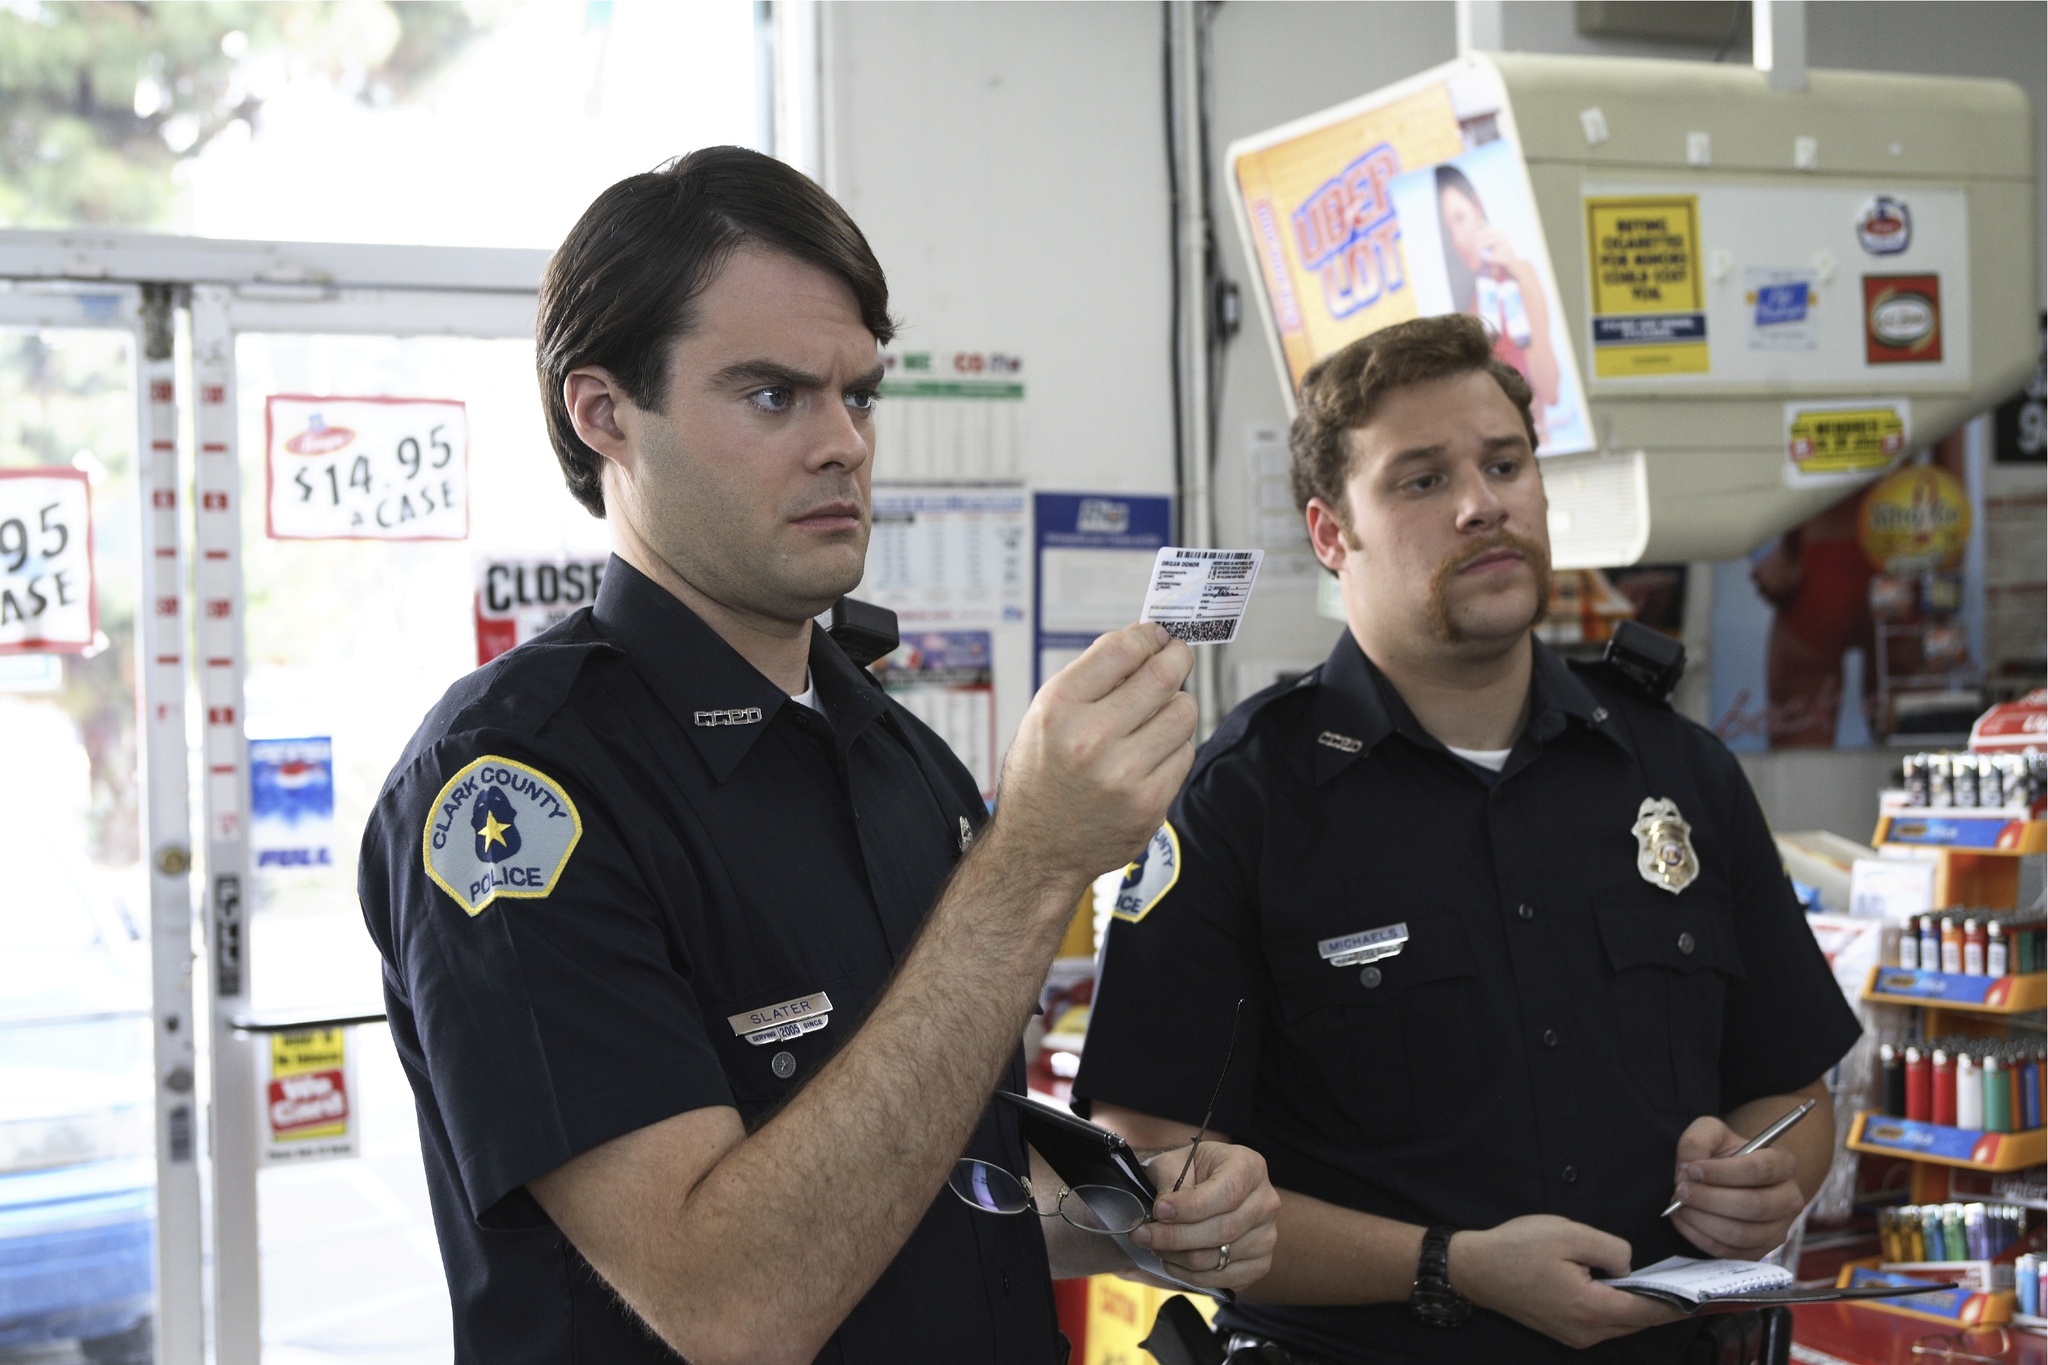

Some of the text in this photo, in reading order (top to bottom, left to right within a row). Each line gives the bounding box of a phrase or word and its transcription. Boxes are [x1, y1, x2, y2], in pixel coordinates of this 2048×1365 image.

[375, 481, 454, 528] CASE
[432, 766, 568, 849] CLARK COUNTY
[469, 866, 544, 902] POLICE
[750, 1000, 812, 1025] SLATER
[752, 1018, 824, 1042] SERVING 2005 SINCE
